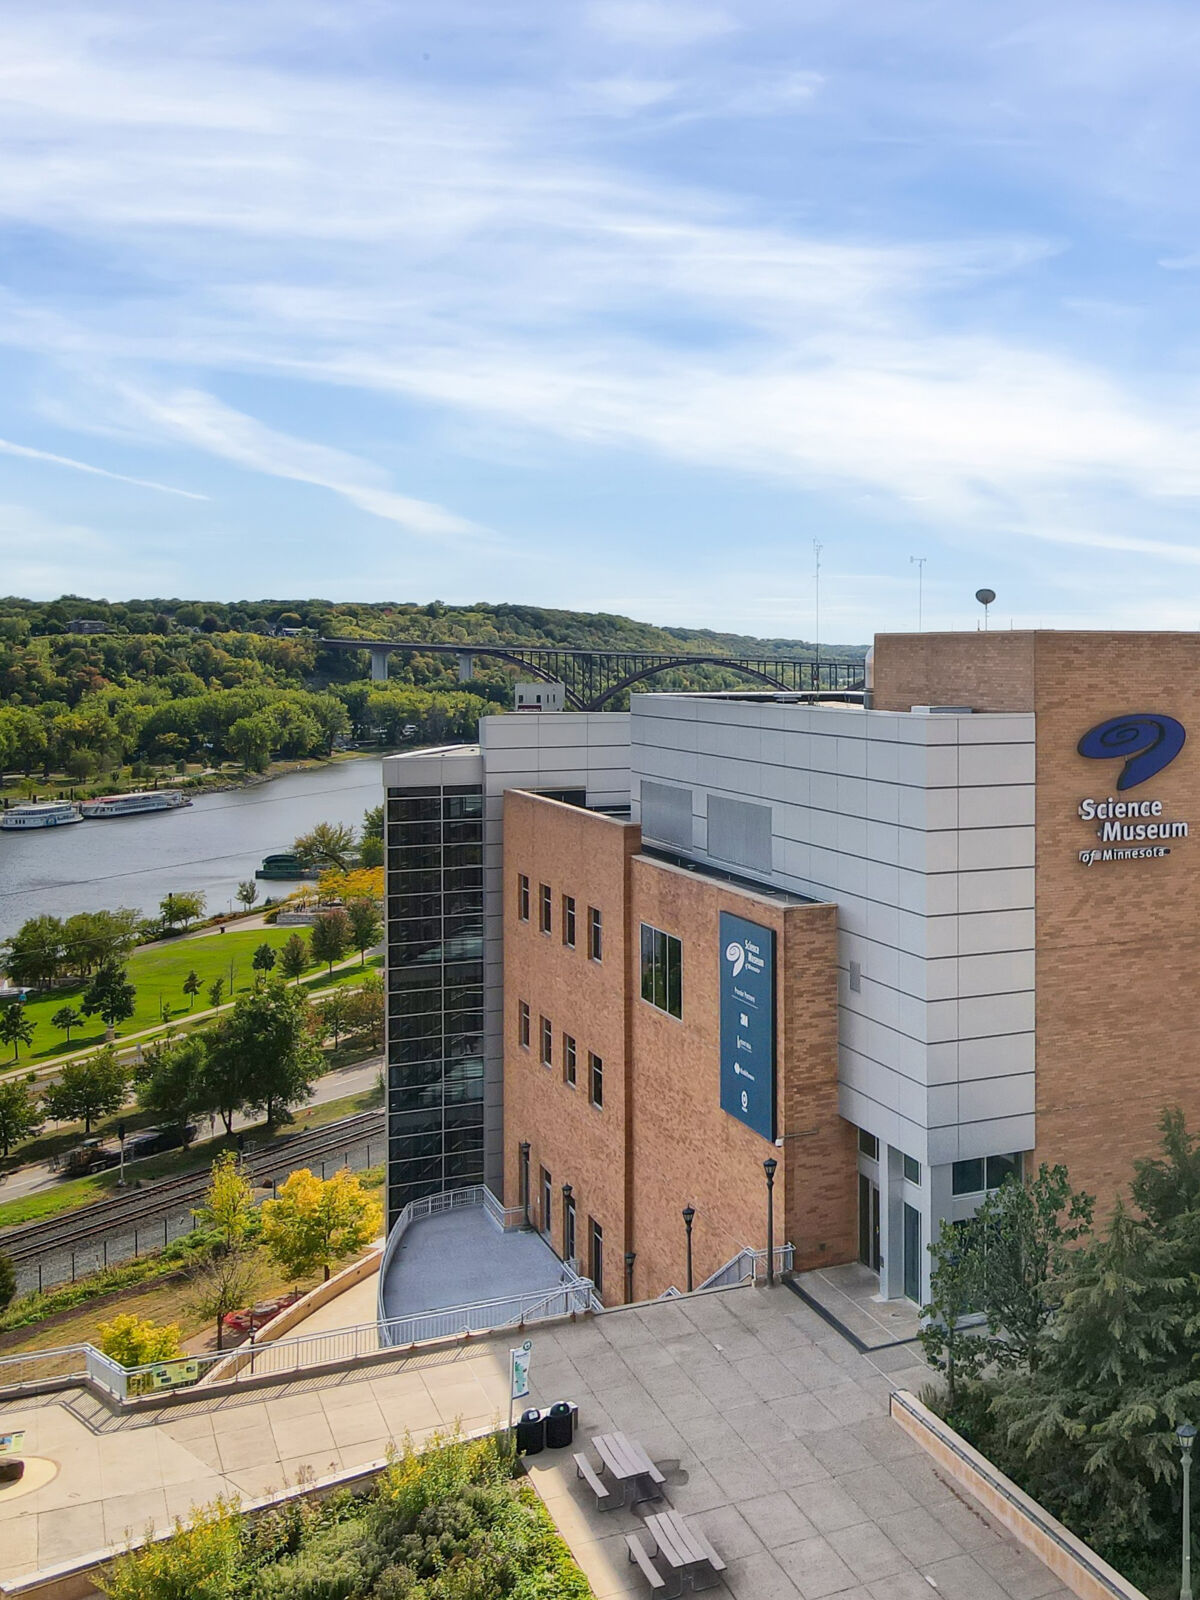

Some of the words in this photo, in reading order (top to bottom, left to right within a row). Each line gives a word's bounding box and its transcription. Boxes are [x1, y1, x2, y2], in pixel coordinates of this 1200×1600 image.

[1081, 797, 1163, 820] Science
[1102, 821, 1188, 842] Museum
[1082, 849, 1097, 867] of
[1102, 846, 1165, 861] Minnesota
